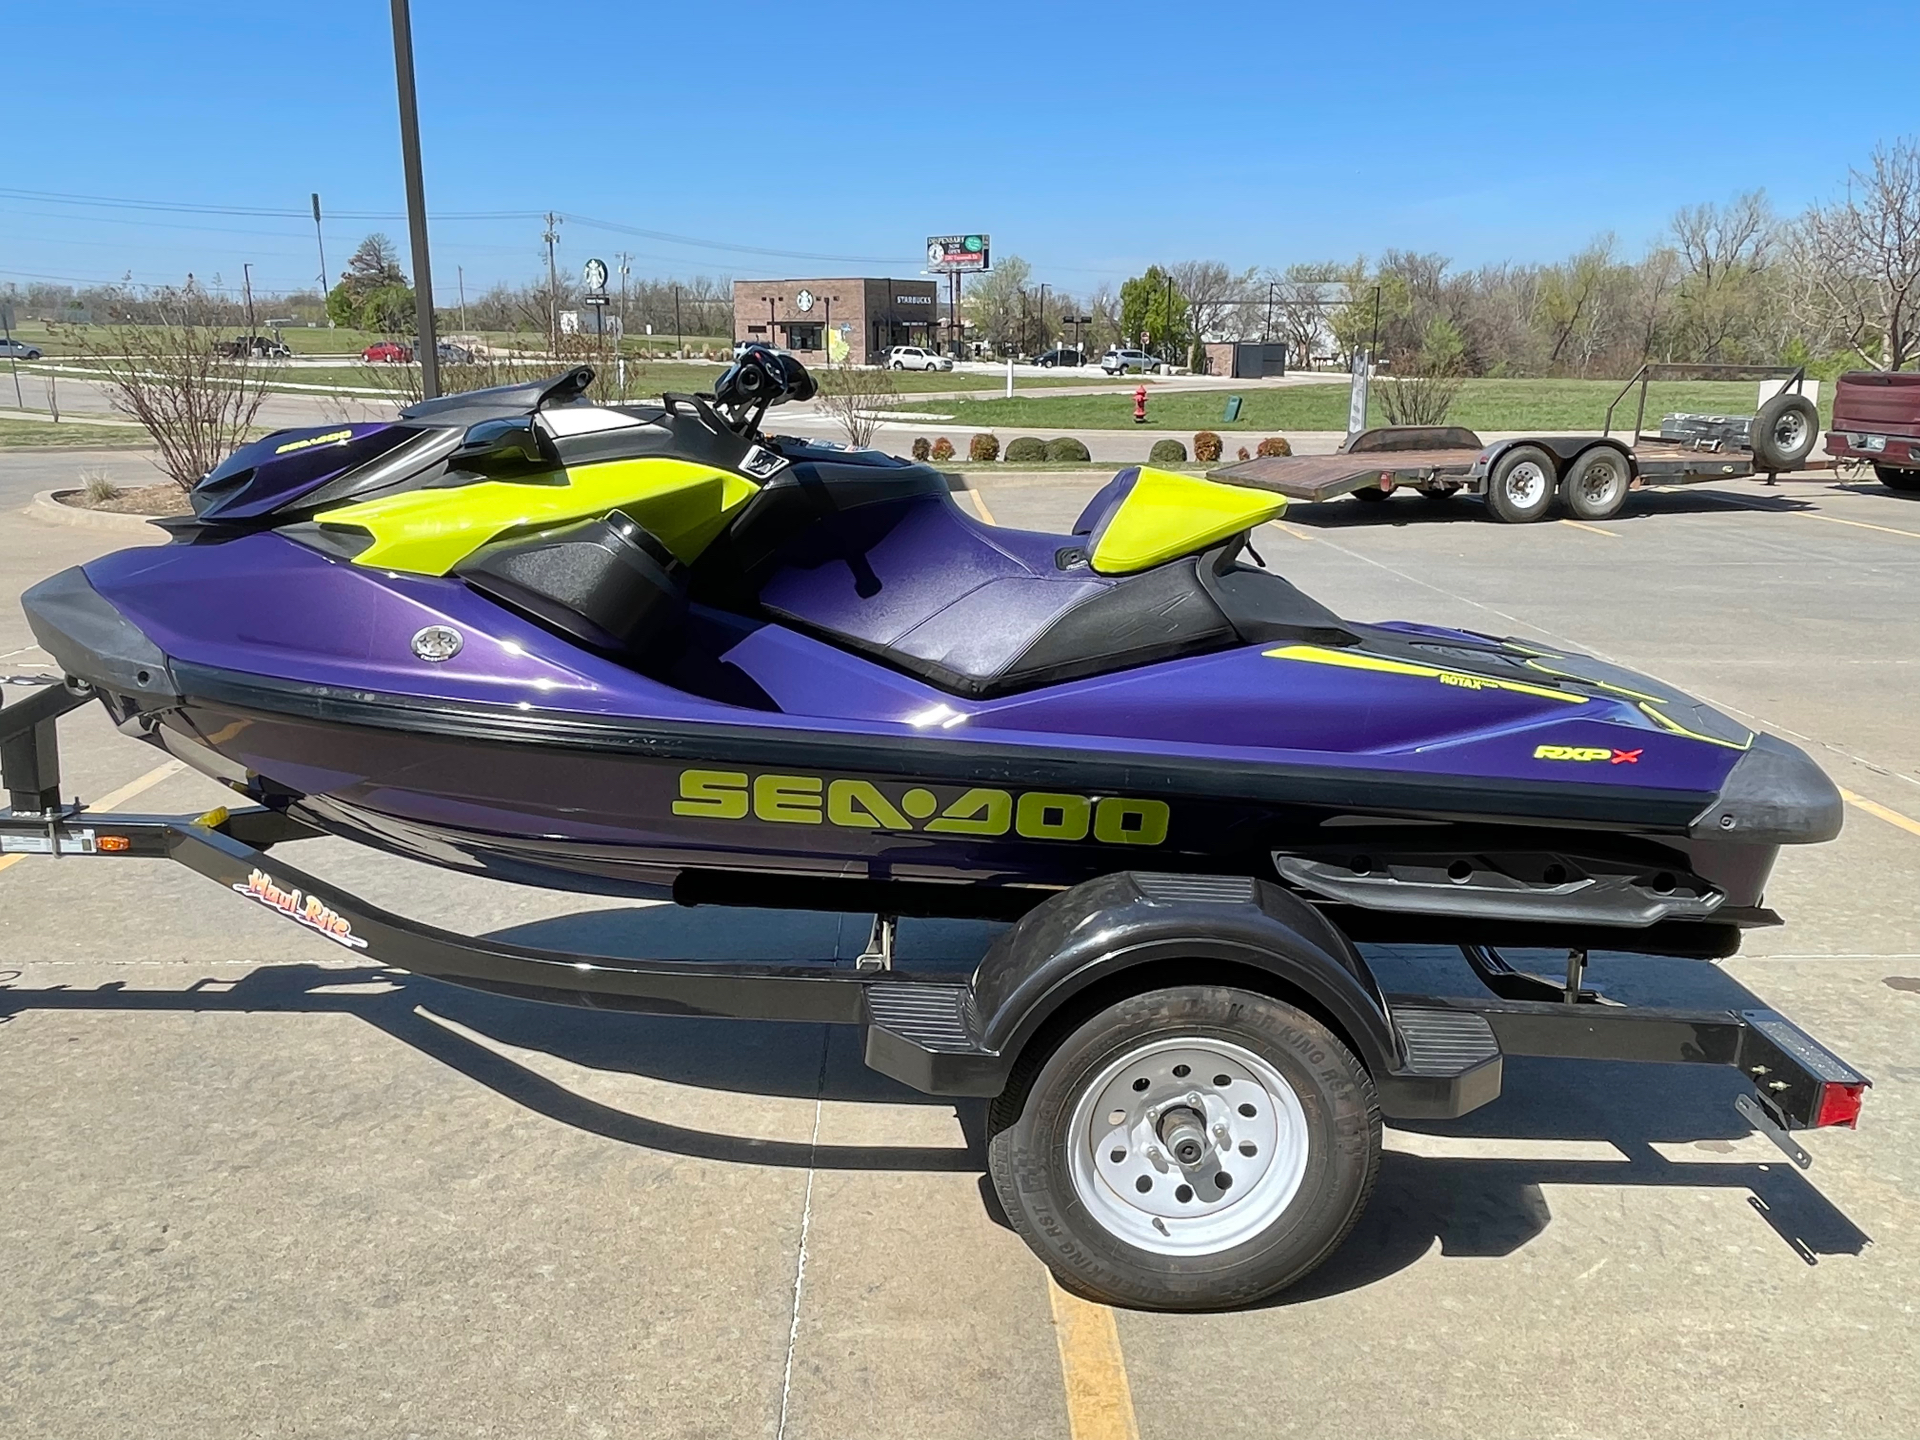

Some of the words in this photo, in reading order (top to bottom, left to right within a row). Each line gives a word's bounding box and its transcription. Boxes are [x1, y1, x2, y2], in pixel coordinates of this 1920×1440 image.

[897, 296, 932, 304] STARBUCKS
[1440, 675, 1481, 690] ROTAX
[248, 868, 301, 912] Haul
[305, 895, 351, 938] Rite
[1282, 1025, 1325, 1065] KING
[1031, 1204, 1064, 1241] RST
[1059, 1242, 1101, 1280] KING
